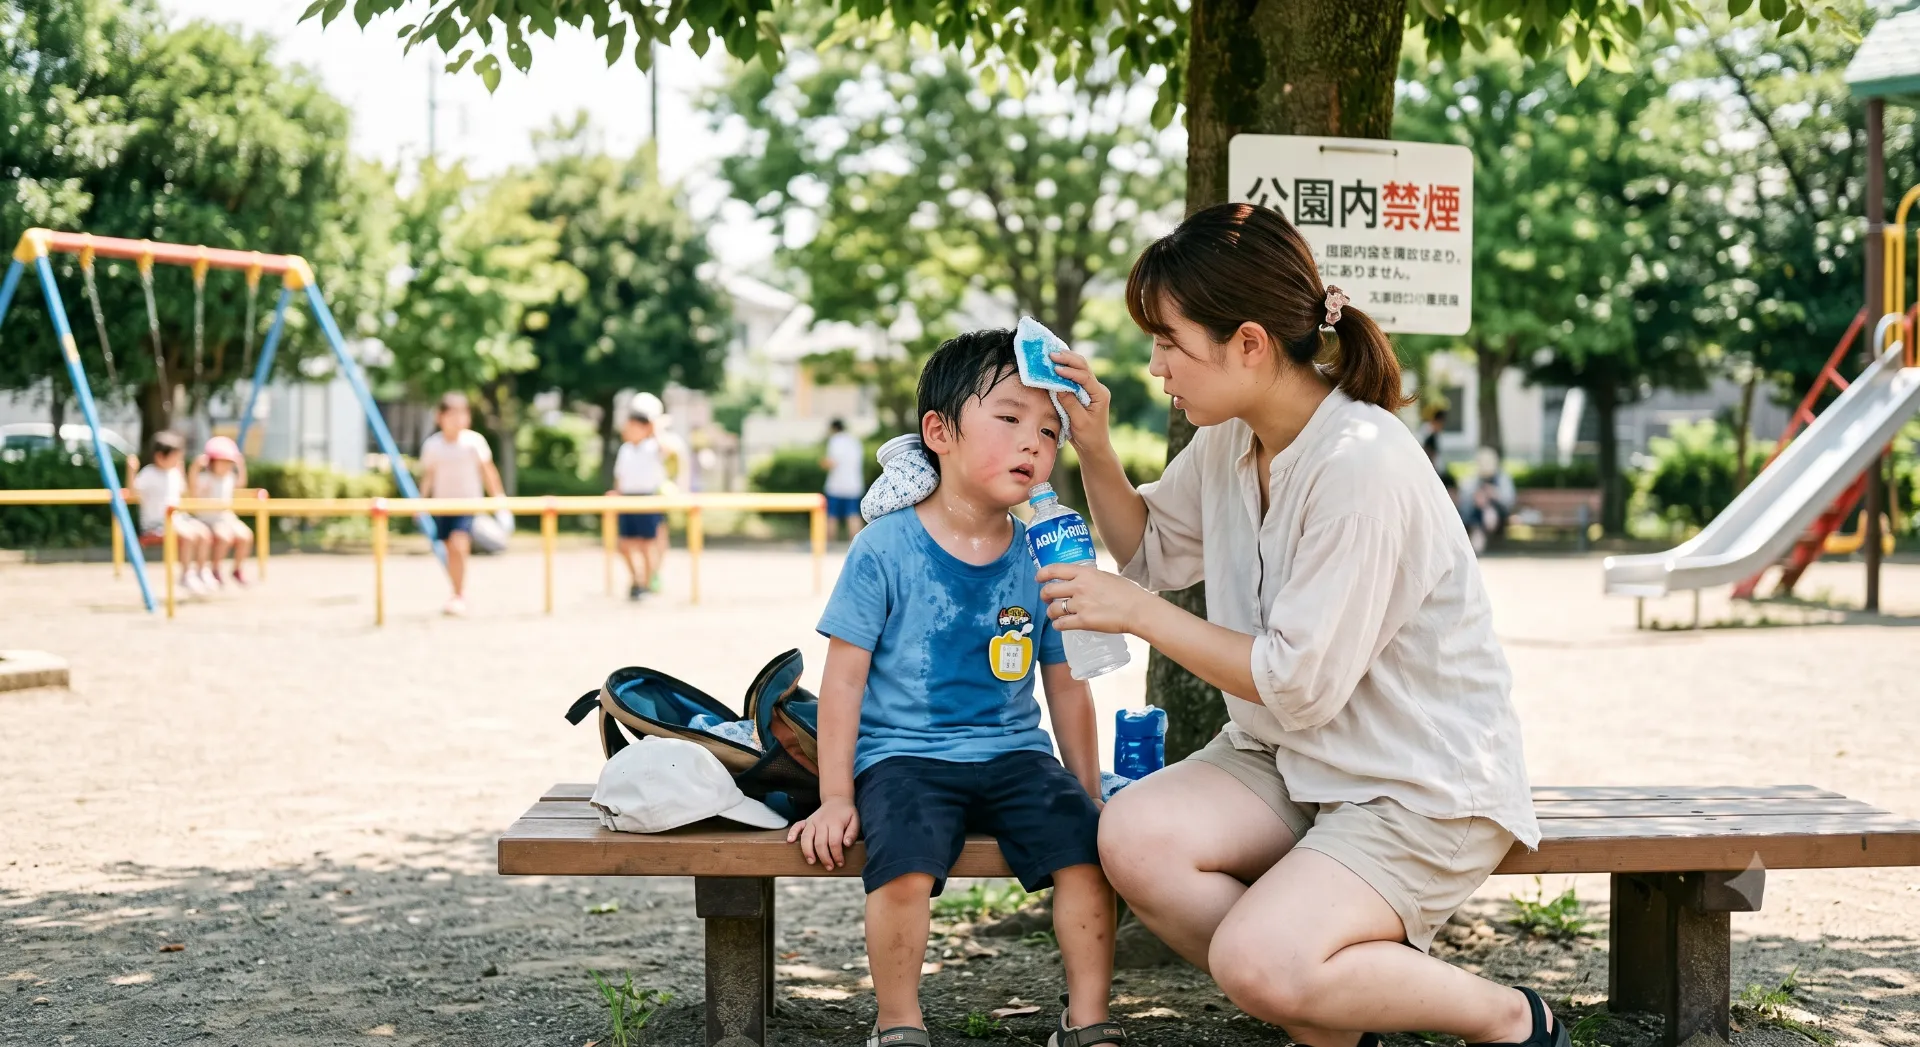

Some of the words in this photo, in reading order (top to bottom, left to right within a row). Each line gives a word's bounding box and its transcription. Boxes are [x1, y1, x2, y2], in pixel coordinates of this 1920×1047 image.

[1246, 177, 1460, 232] 公園内禁煙
[1036, 523, 1088, 551] AQUARIUS
